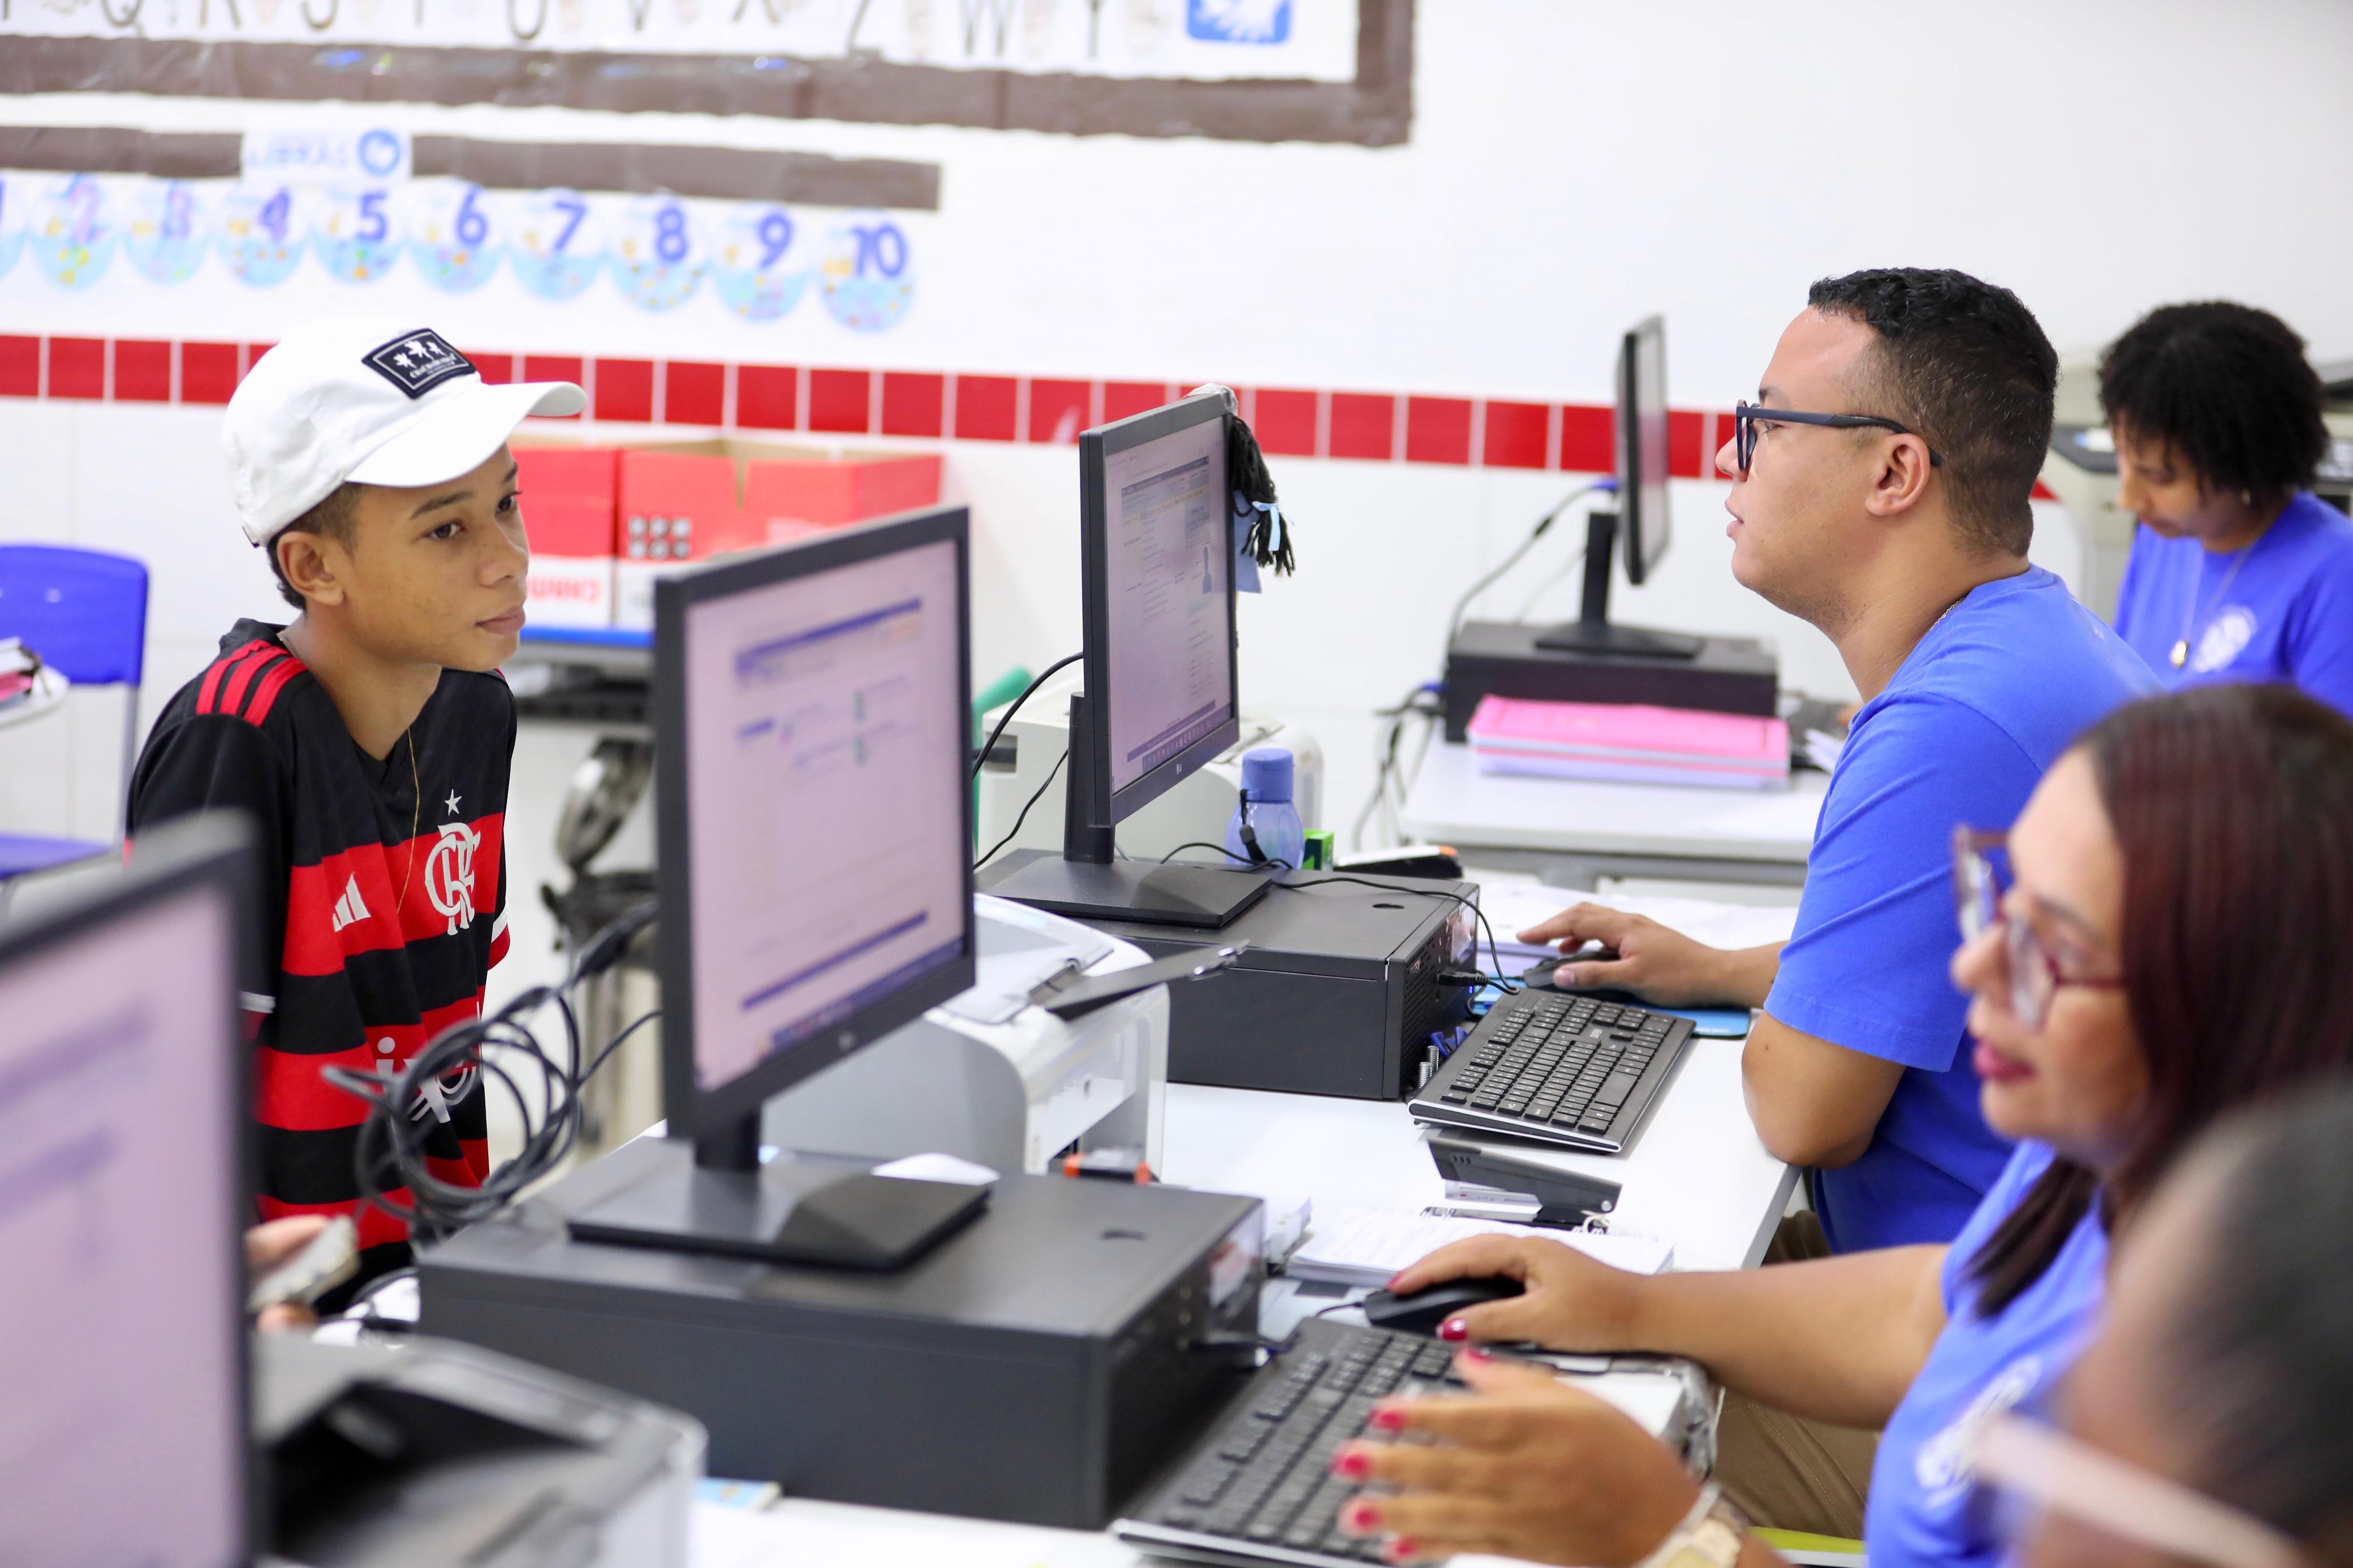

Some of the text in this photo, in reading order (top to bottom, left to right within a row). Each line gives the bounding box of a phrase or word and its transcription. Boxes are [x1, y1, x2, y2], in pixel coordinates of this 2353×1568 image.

[258, 187, 292, 242] 4
[357, 190, 389, 243] 5
[455, 185, 488, 247] 6
[554, 200, 588, 251] 7
[654, 207, 688, 263] 8
[758, 213, 794, 269] 9
[851, 223, 907, 278] 10
